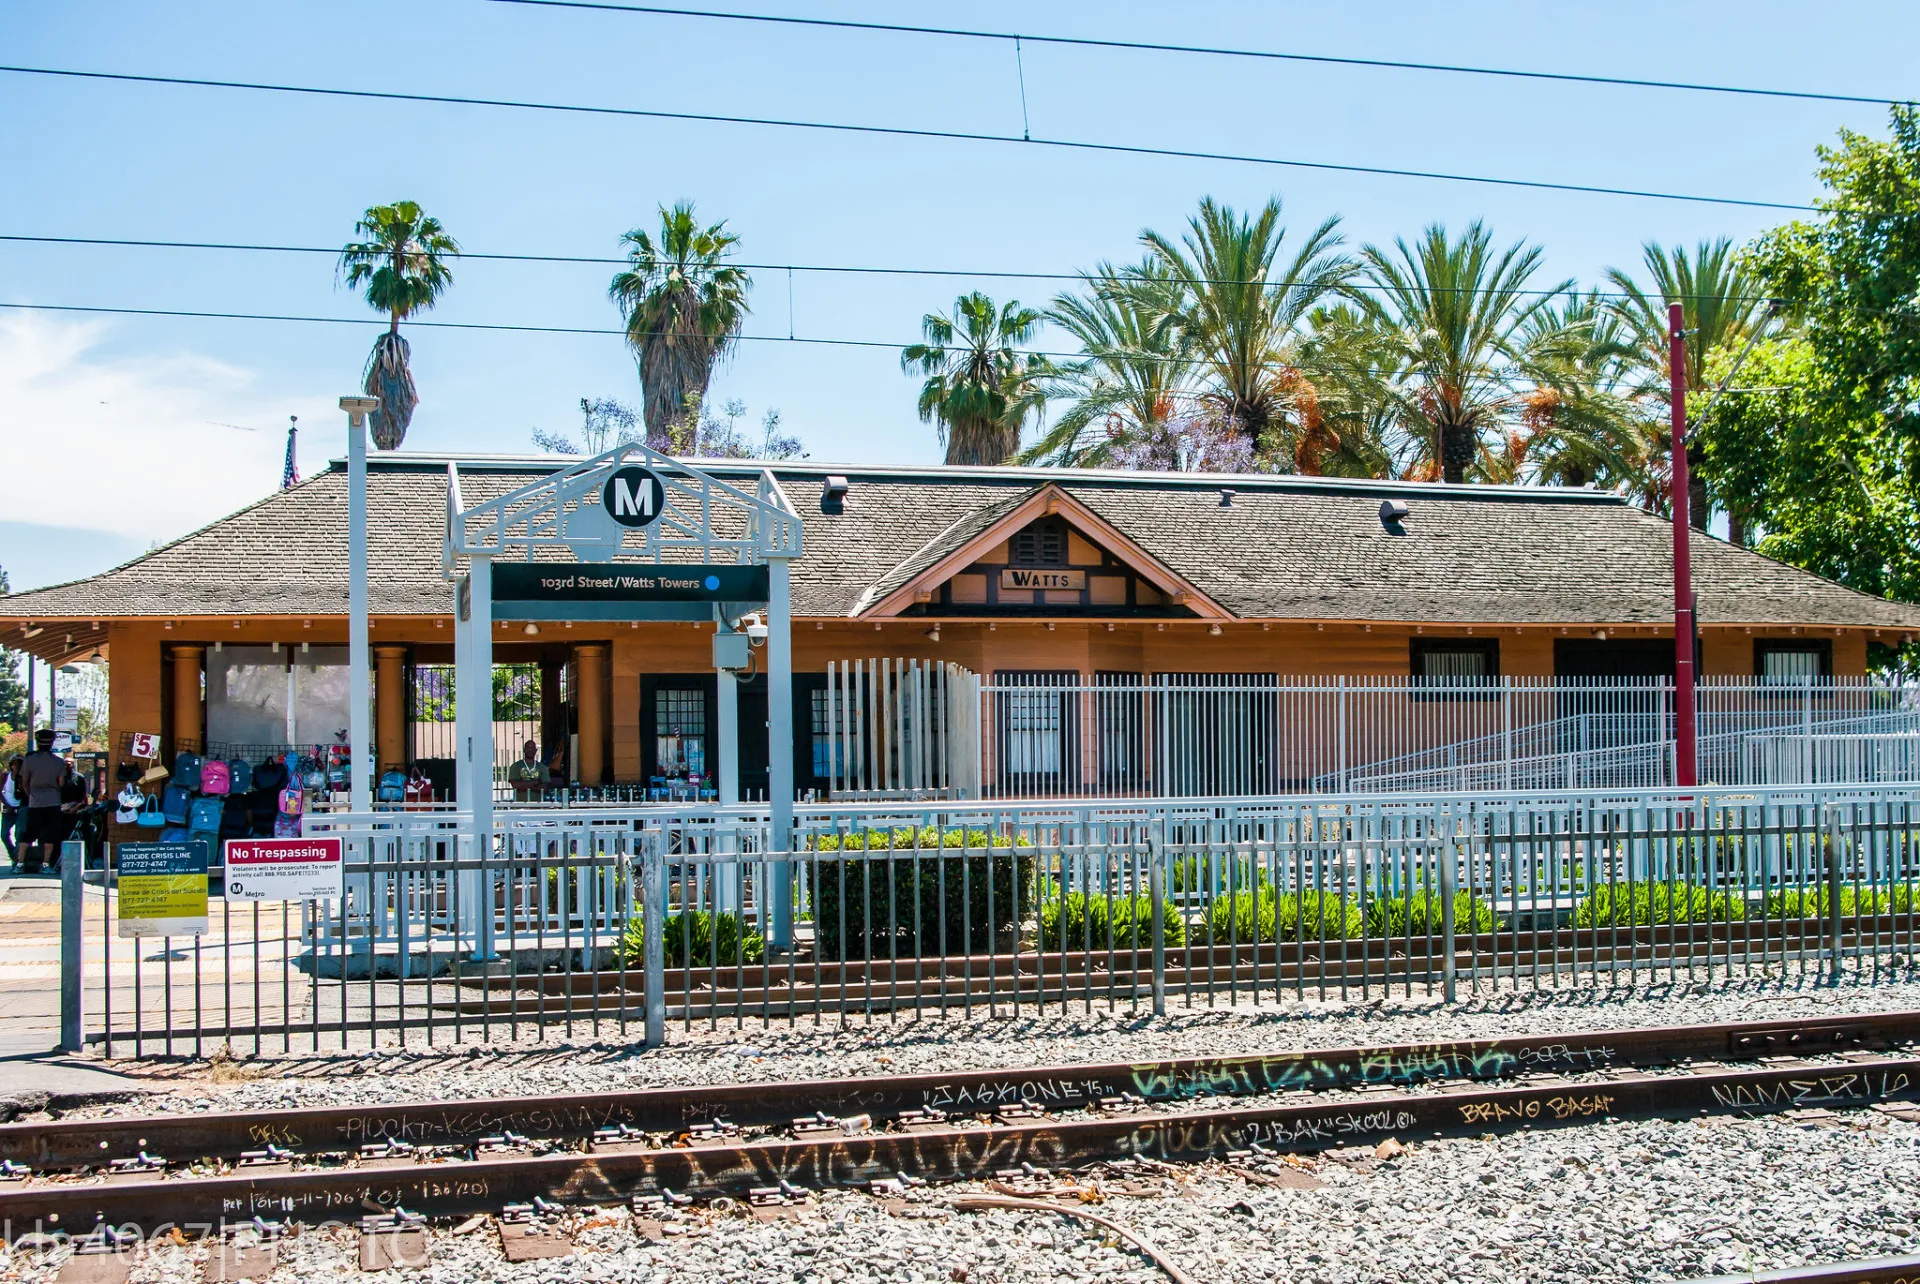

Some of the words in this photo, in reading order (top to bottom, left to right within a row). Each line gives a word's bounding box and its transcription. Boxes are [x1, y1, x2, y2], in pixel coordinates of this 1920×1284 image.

[615, 478, 653, 516] M
[541, 575, 574, 590] 103rd
[577, 575, 655, 588] Street/Watts
[658, 576, 700, 589] Towers
[232, 848, 249, 859] No
[252, 846, 327, 860] Trespassing
[1459, 1100, 1541, 1124] BRAVO
